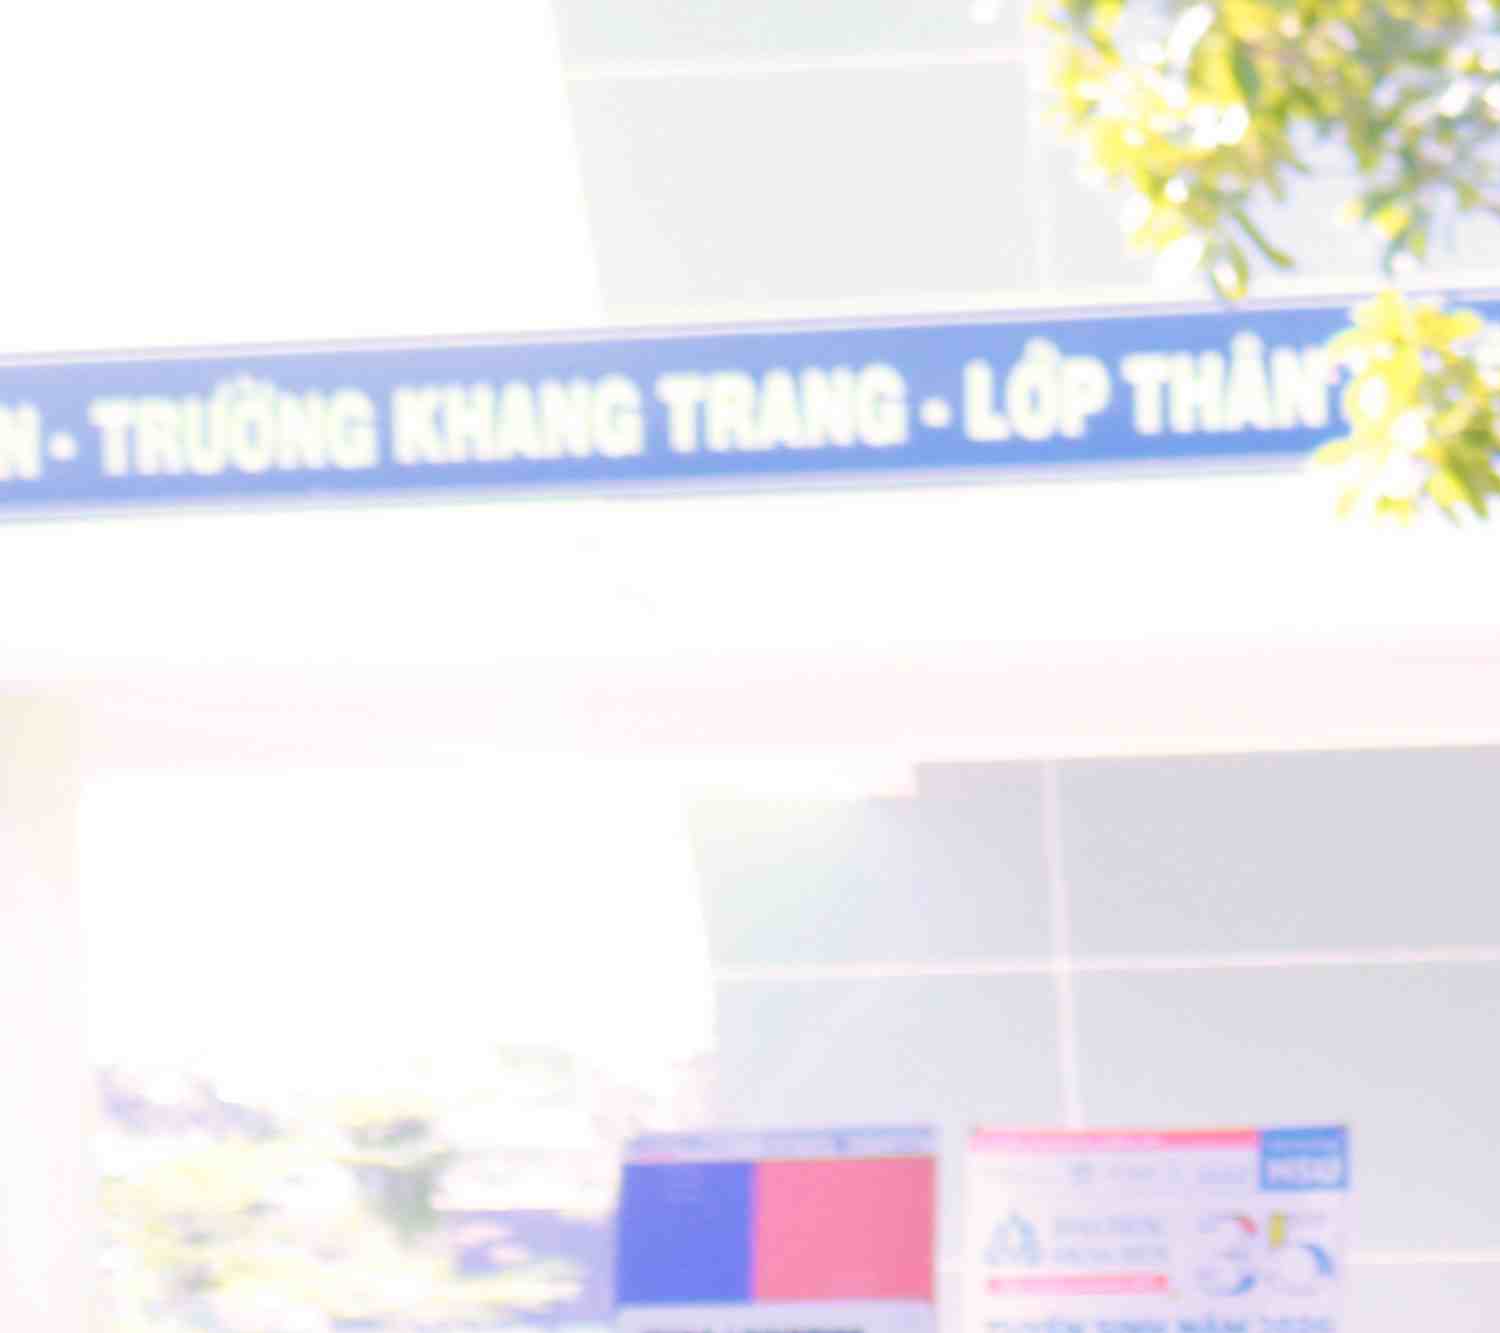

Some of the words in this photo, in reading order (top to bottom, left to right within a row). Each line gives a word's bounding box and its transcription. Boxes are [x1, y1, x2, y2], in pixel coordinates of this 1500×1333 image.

[394, 376, 644, 467] KHANG
[658, 364, 908, 452] TRANG
[964, 338, 1112, 444] LỚP
